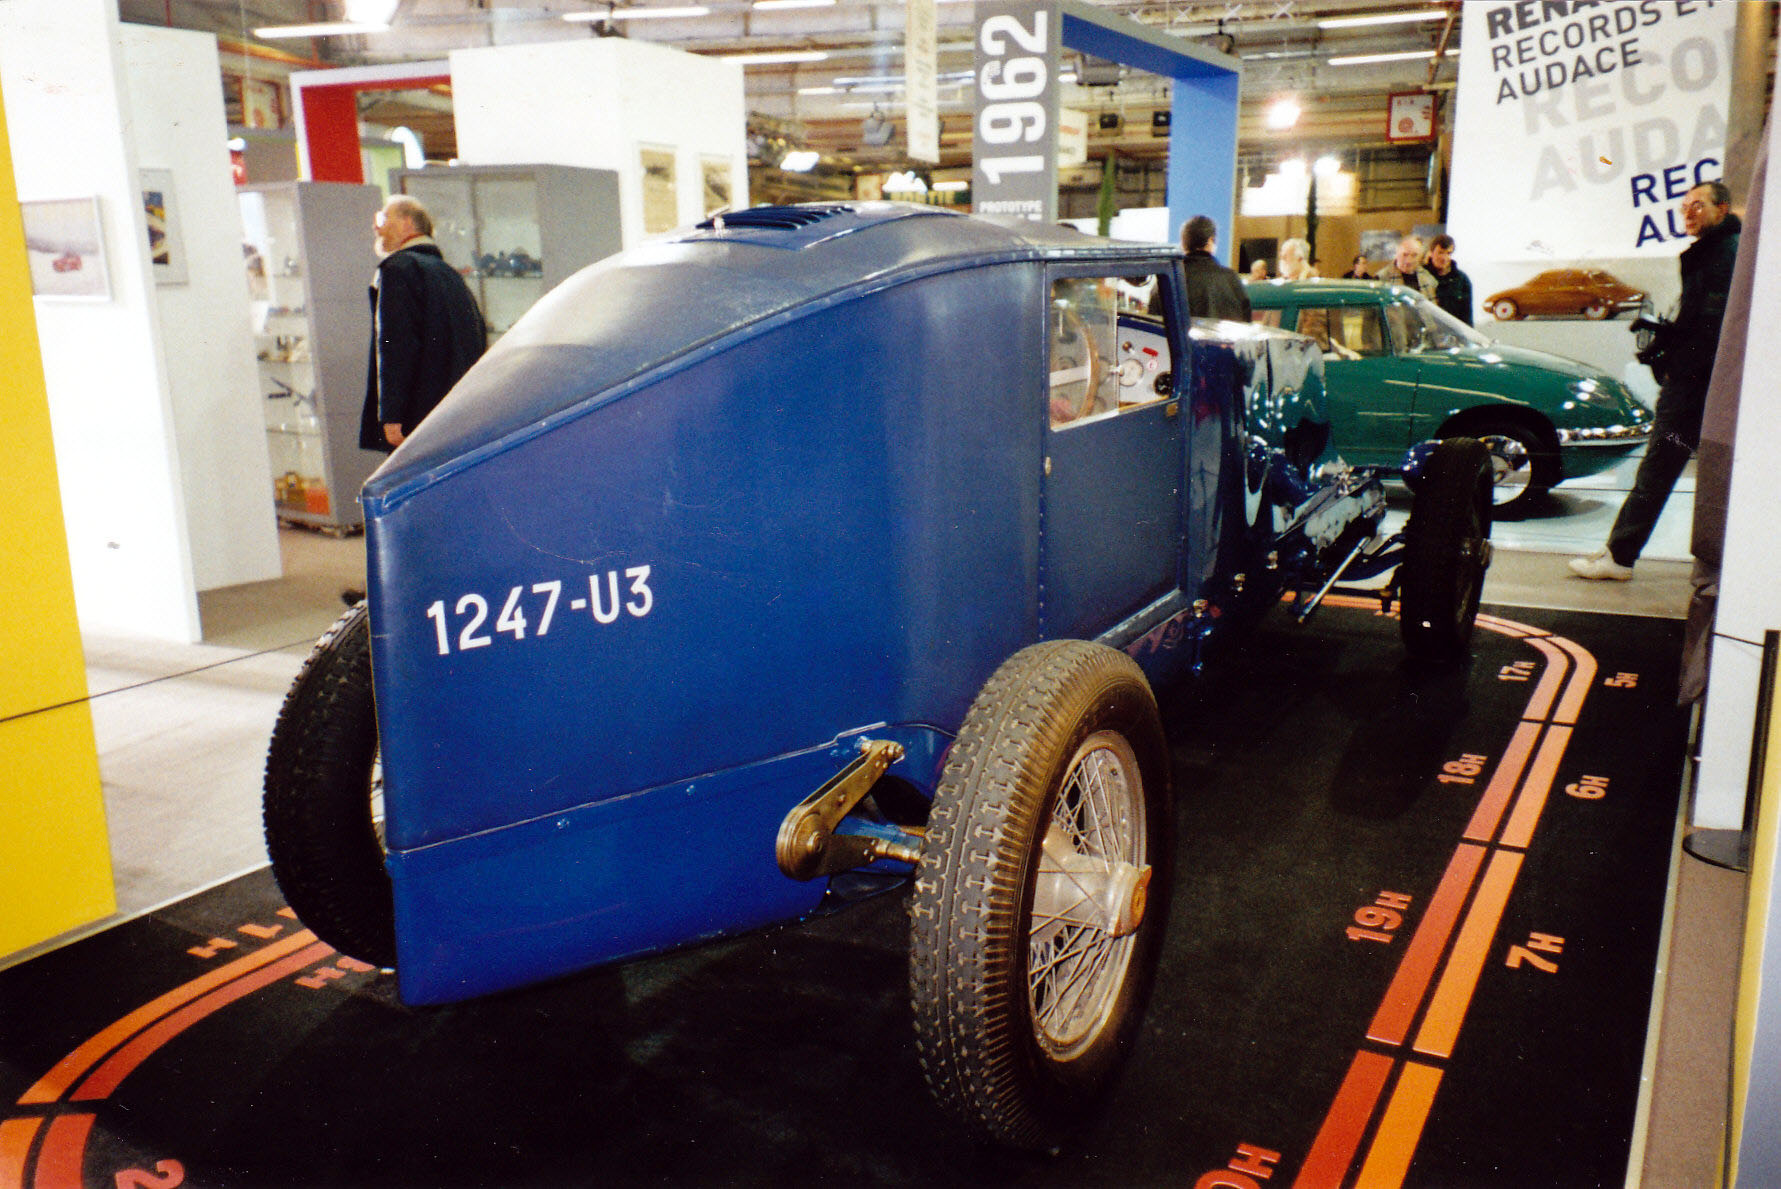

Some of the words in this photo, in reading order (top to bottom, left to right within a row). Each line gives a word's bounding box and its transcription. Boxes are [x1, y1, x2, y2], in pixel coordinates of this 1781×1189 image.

[1491, 0, 1662, 72] RECORDS
[1676, 0, 1714, 17] E
[979, 10, 1048, 185] 1962
[1496, 38, 1642, 105] AUDACE
[1521, 27, 1737, 135] RECO
[427, 564, 653, 655] 1247-U3
[1497, 660, 1536, 682] 17H
[1603, 671, 1639, 688] 5H
[1437, 753, 1488, 784] 18H
[1565, 774, 1610, 800] 6H
[1345, 890, 1413, 944] 19H
[1505, 931, 1565, 974] 7H
